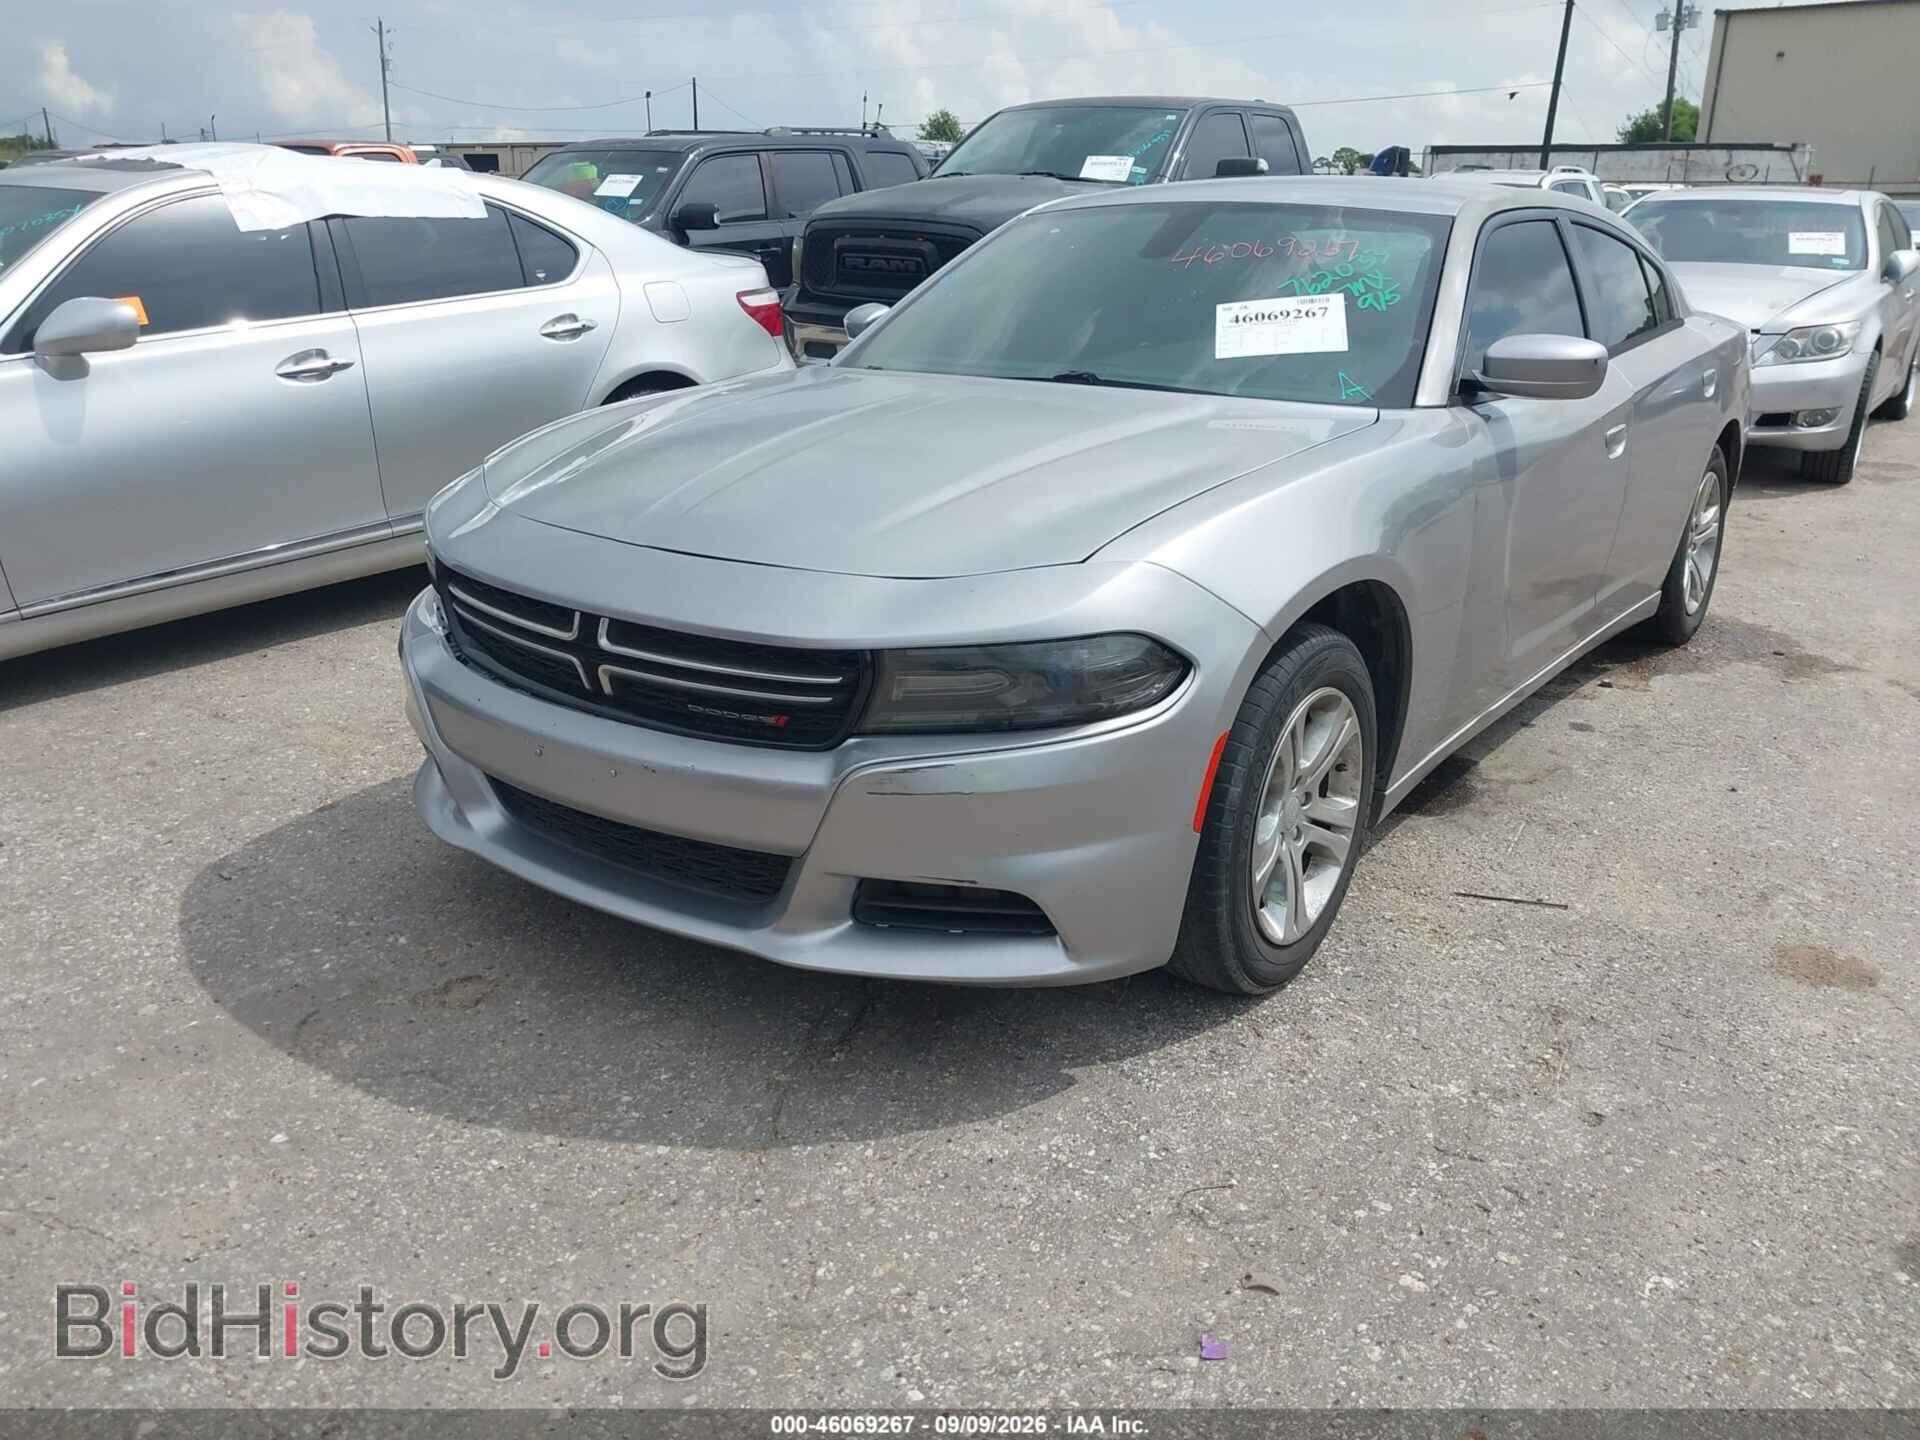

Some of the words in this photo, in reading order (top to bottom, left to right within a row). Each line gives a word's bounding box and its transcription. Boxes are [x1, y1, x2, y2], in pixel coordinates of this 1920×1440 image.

[844, 257, 918, 274] RAM
[1229, 306, 1329, 325] 46069267
[687, 704, 776, 724] DODGE
